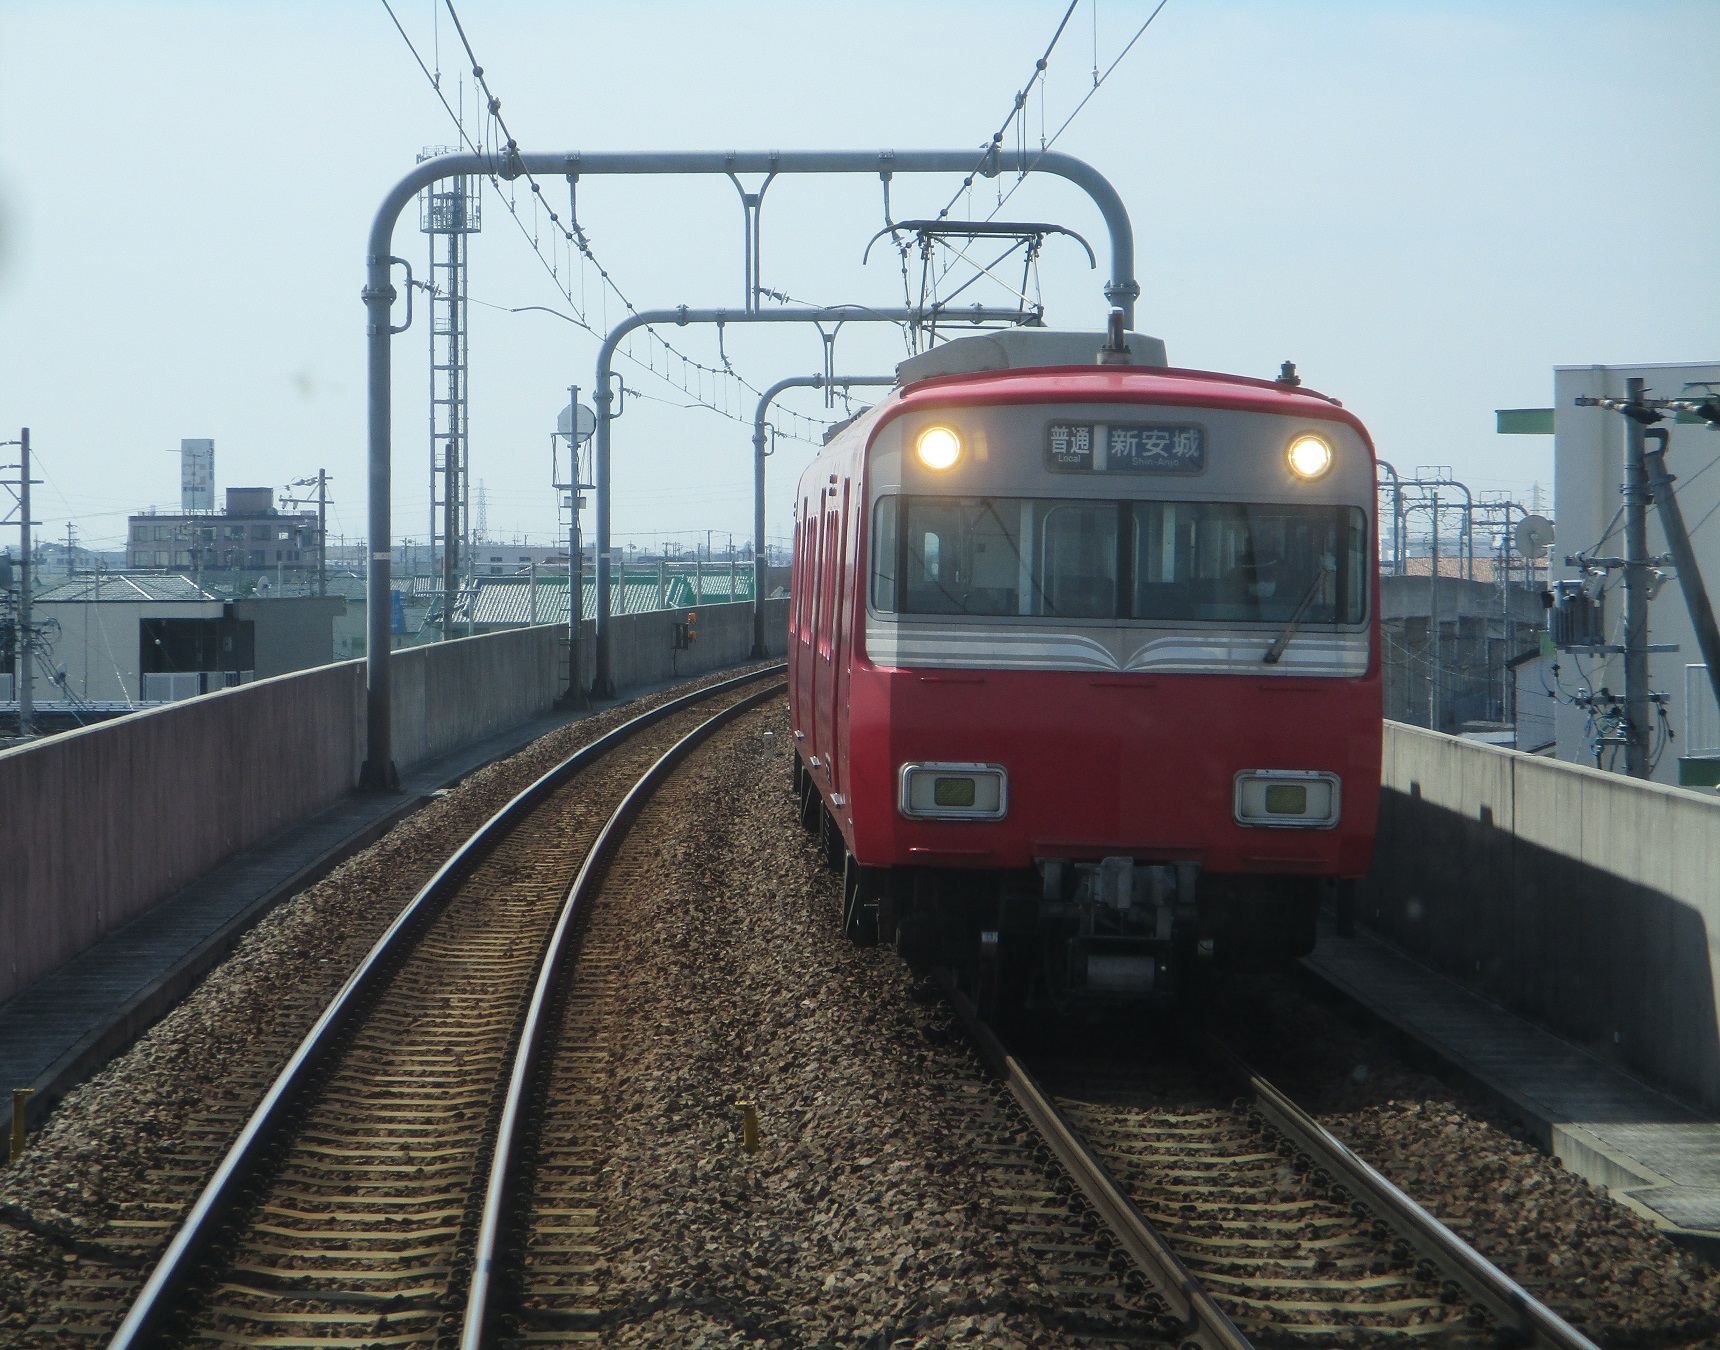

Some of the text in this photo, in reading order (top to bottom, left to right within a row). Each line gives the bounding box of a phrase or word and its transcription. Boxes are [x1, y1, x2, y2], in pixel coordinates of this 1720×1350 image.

[1051, 426, 1090, 454] 普通
[1111, 429, 1200, 458] 新安城
[1058, 454, 1081, 463] Local
